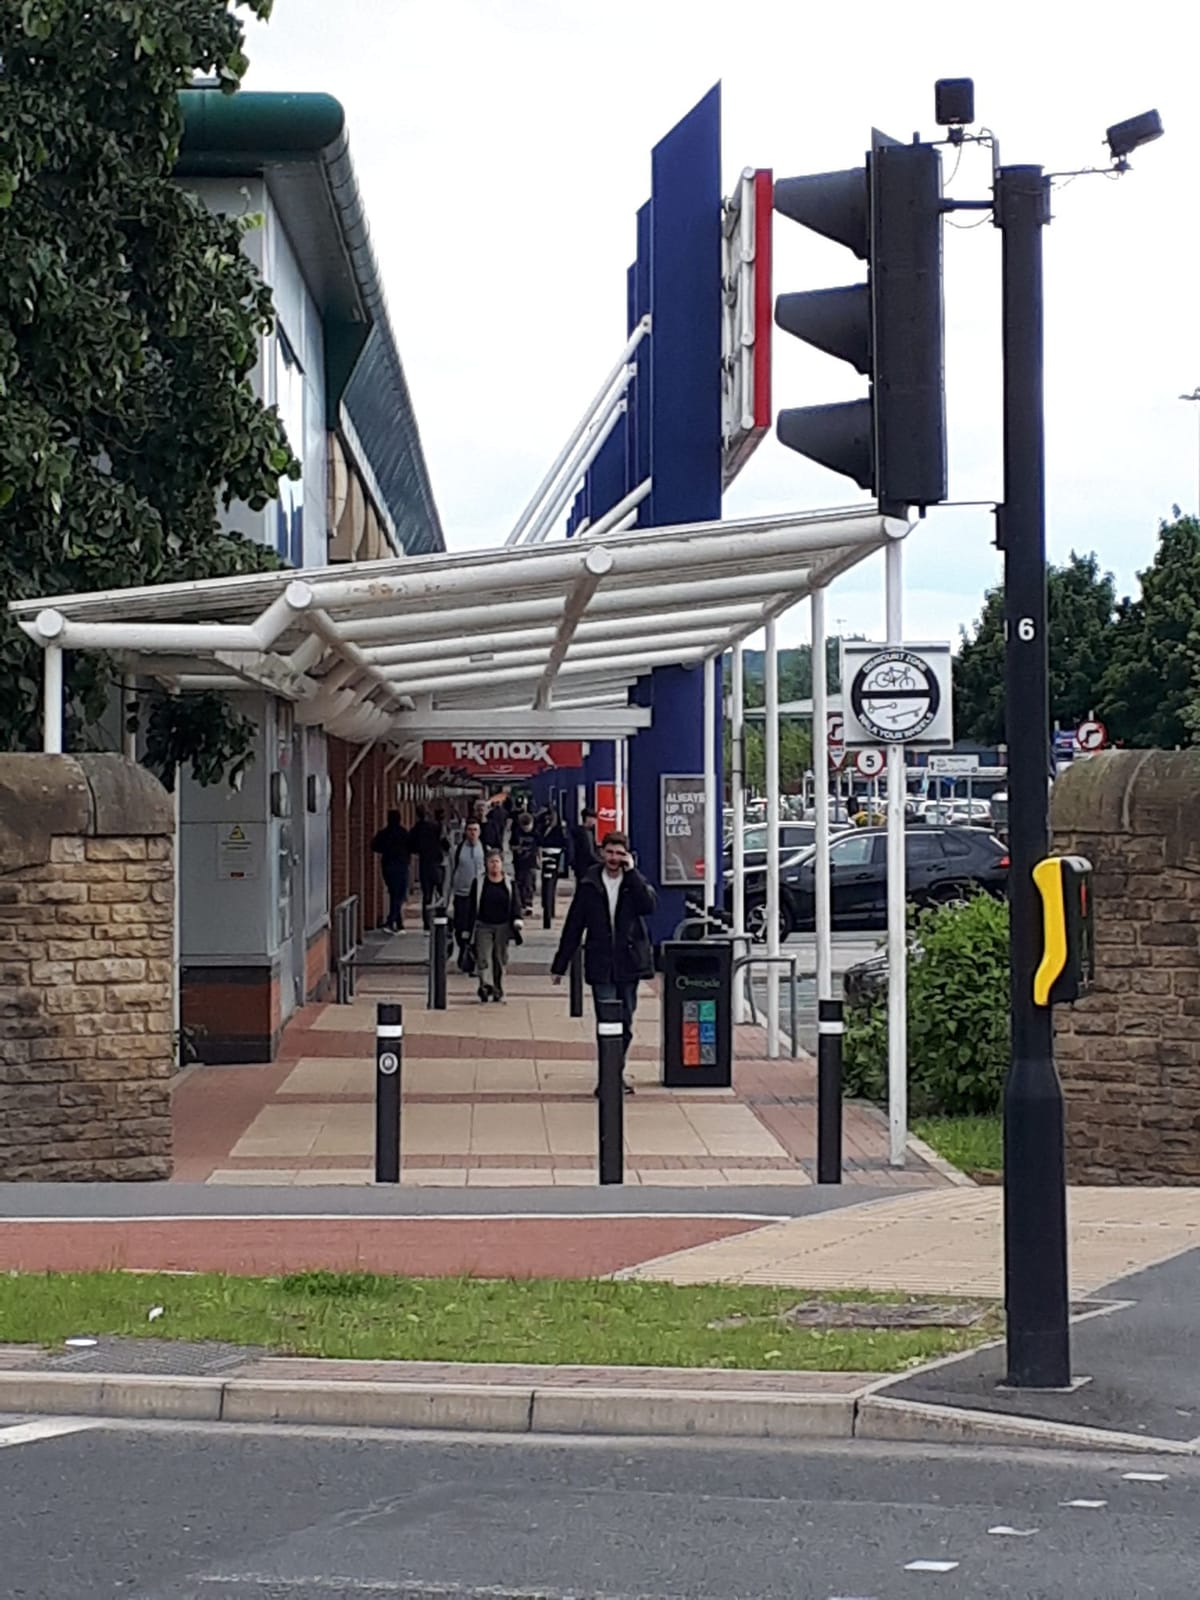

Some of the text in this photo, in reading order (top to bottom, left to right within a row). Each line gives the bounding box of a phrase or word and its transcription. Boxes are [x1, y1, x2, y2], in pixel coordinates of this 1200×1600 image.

[1018, 618, 1035, 640] 6
[866, 756, 874, 767] 5
[666, 804, 695, 814] UP TO
[666, 826, 692, 836] LESS
